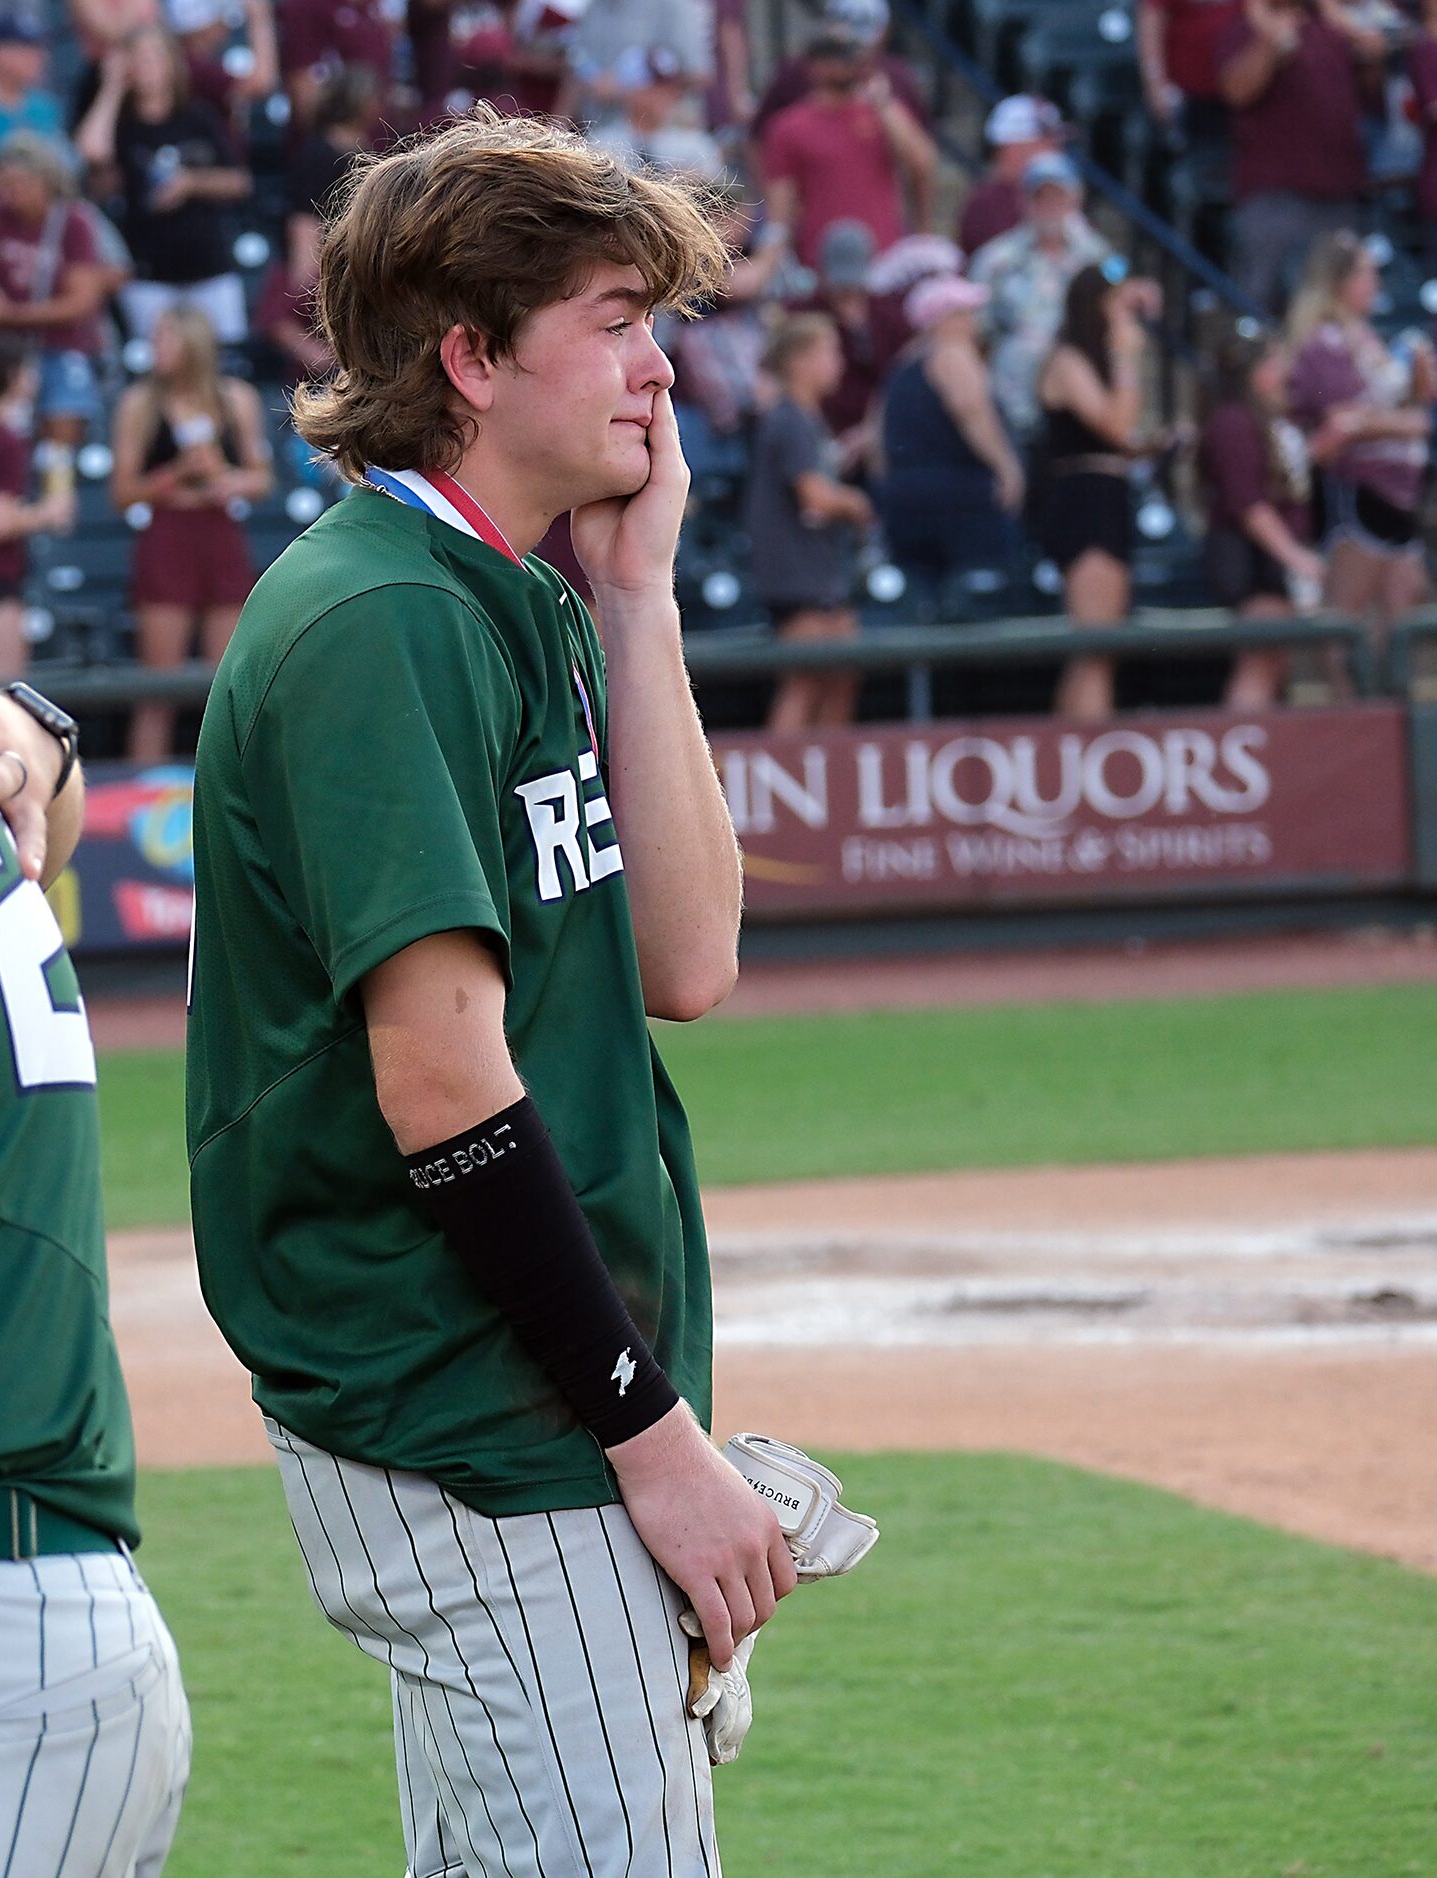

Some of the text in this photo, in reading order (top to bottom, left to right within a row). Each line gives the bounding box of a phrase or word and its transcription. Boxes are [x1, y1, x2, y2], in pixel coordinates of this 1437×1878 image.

[723, 724, 1271, 839] IN LIQUORS
[514, 751, 624, 901] RE
[842, 834, 935, 883] FINE
[947, 829, 1066, 877] WINE
[1115, 822, 1272, 871] SPIRITS
[758, 1483, 801, 1511] BRUCE
